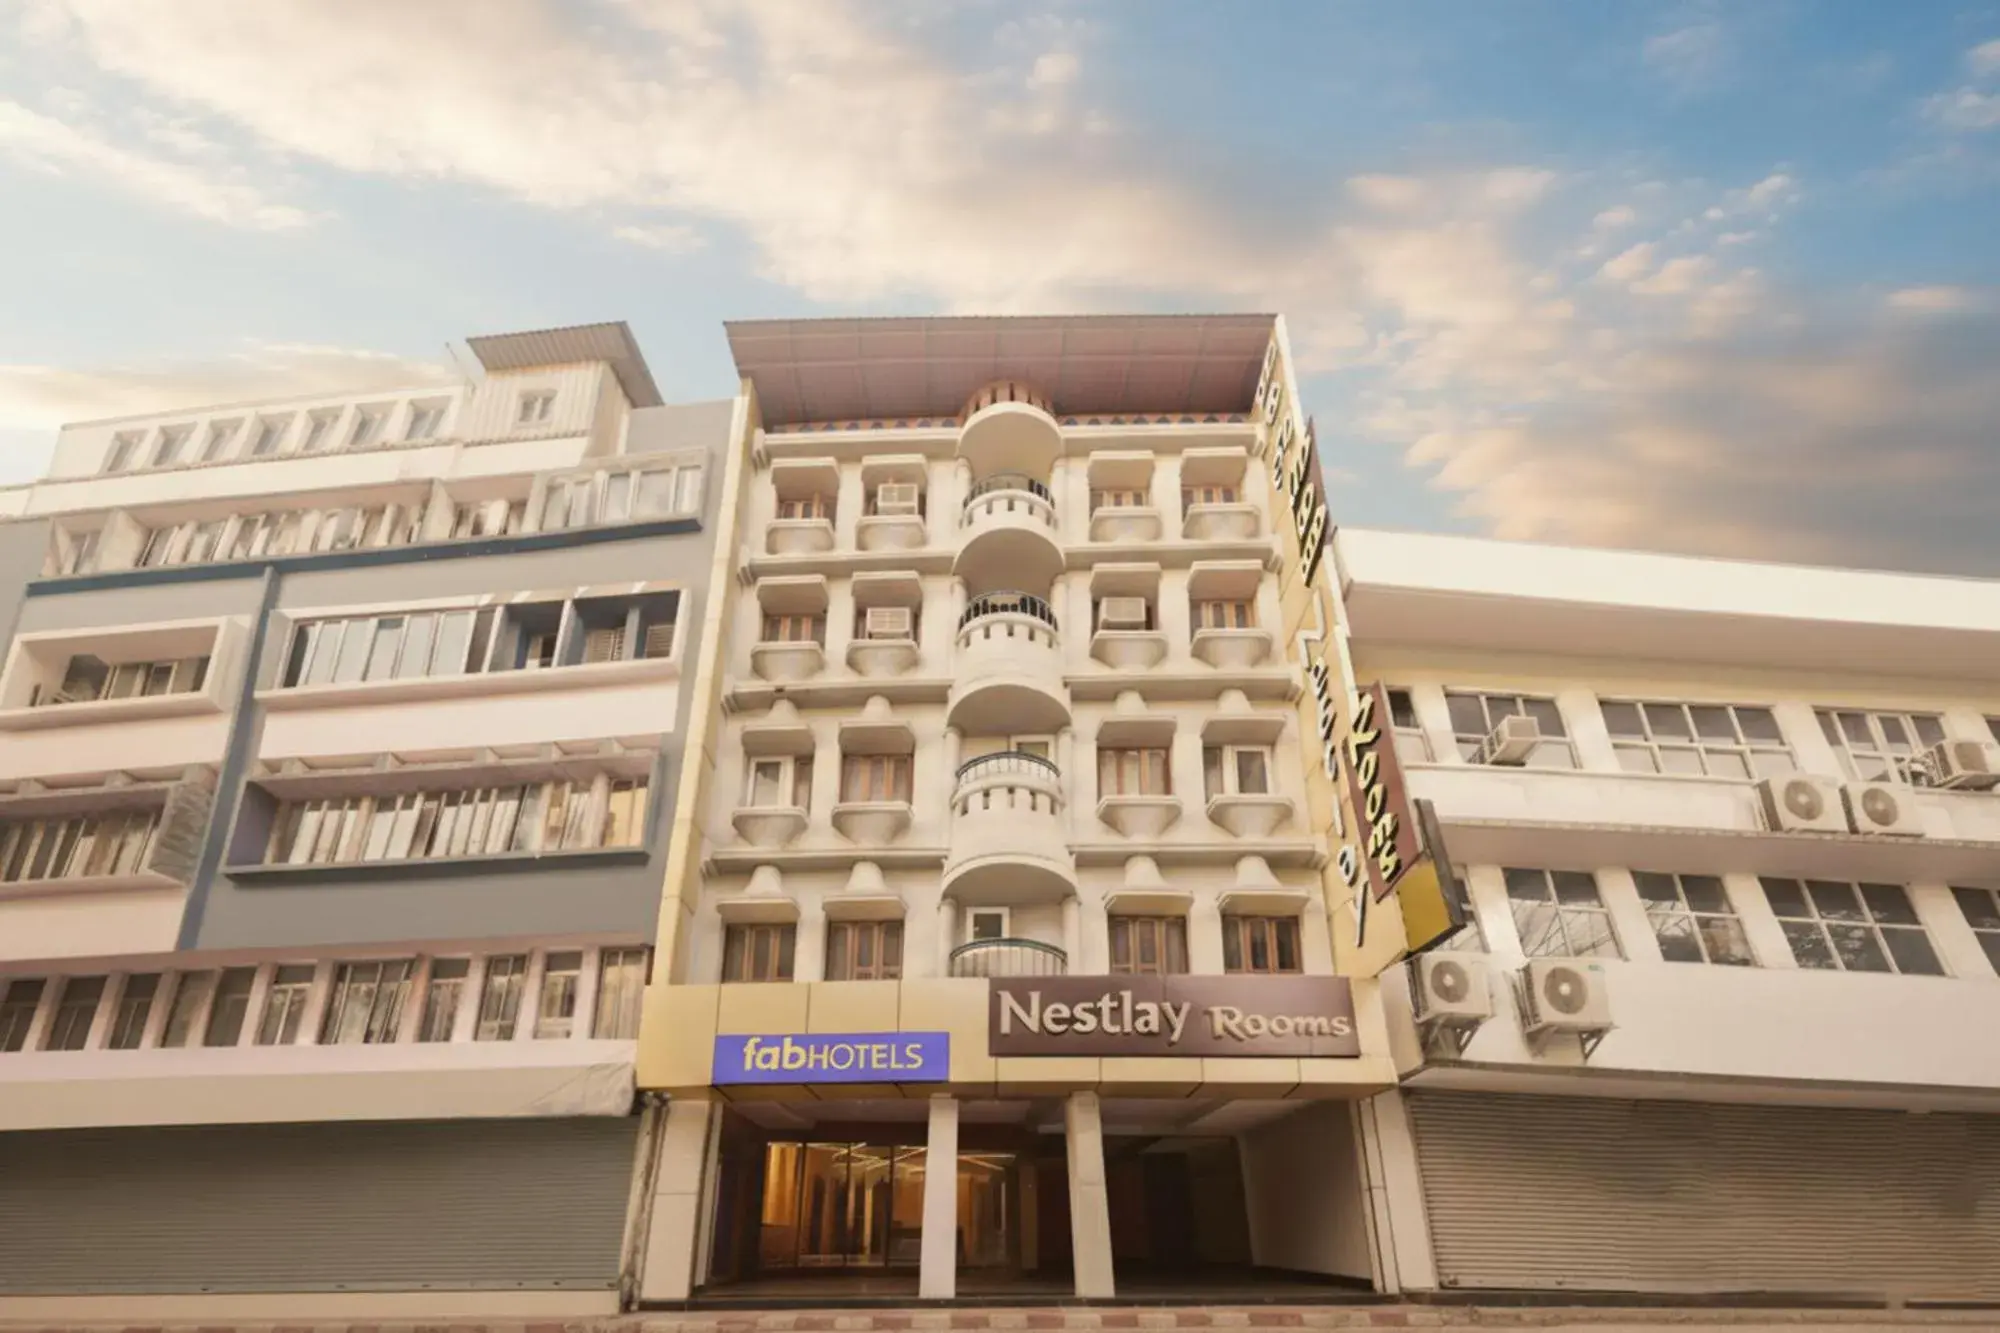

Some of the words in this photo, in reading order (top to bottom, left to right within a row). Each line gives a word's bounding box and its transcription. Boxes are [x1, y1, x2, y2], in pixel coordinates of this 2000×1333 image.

[997, 989, 1191, 1045] Nestlay
[1205, 1004, 1351, 1042] Rooms
[743, 1036, 924, 1072] fabHOTELS
